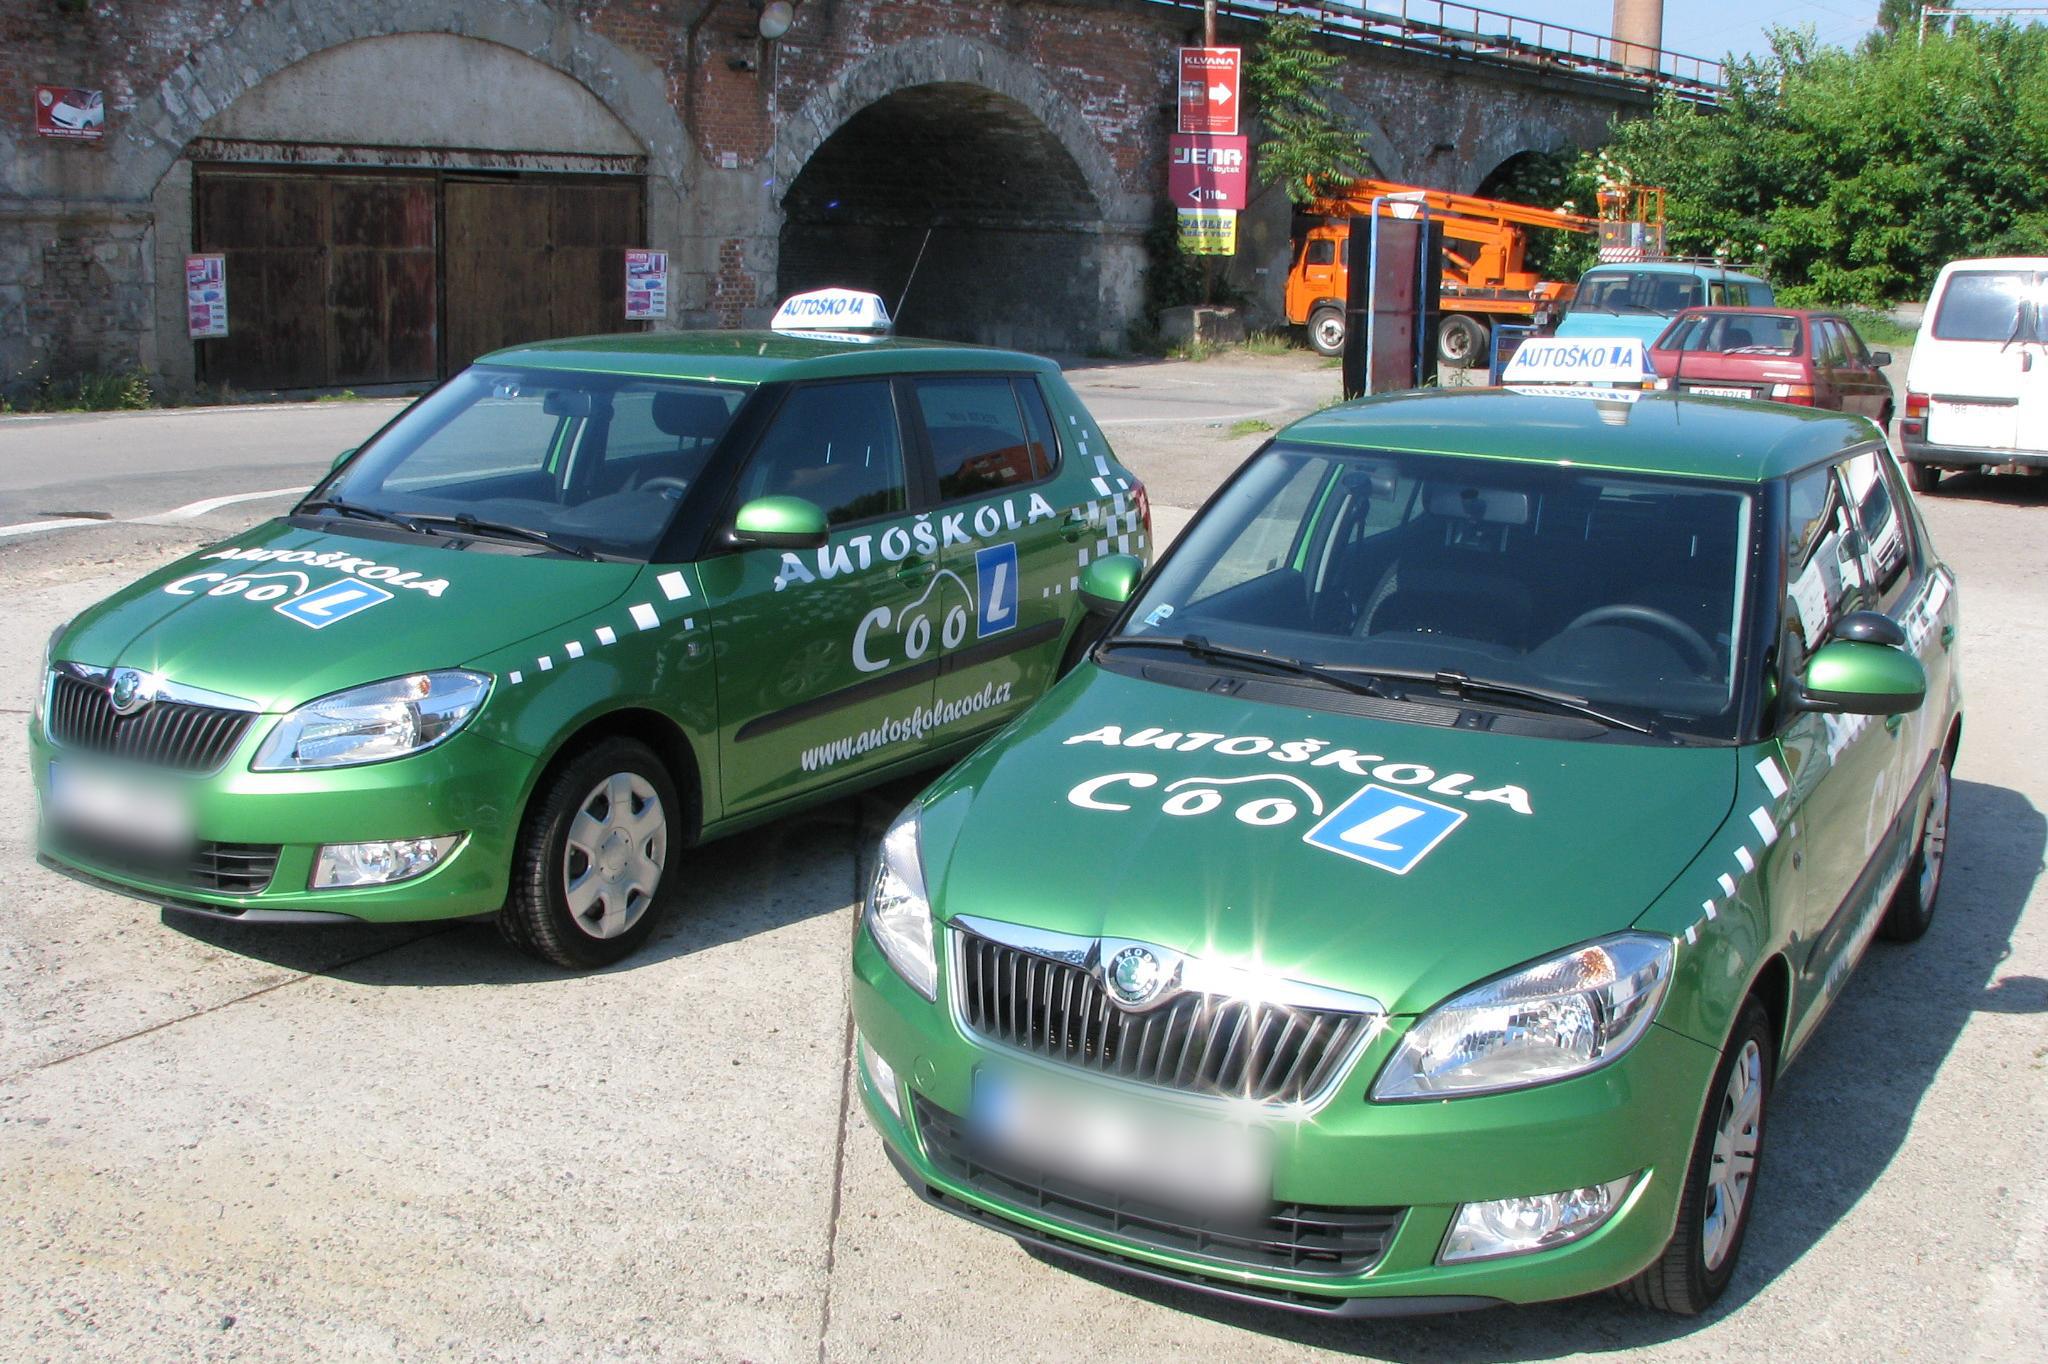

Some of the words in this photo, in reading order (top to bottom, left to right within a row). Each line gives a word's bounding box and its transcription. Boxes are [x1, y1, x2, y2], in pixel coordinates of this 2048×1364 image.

[1184, 56, 1234, 65] KLVANA
[1173, 147, 1242, 166] JENA
[200, 547, 450, 597] AUTOŠKOLA
[774, 492, 1057, 592] AUTOŠKOLA
[801, 680, 1012, 772] www.autoskolacool.cz
[1063, 726, 1534, 815] AUTOŠKOLA
